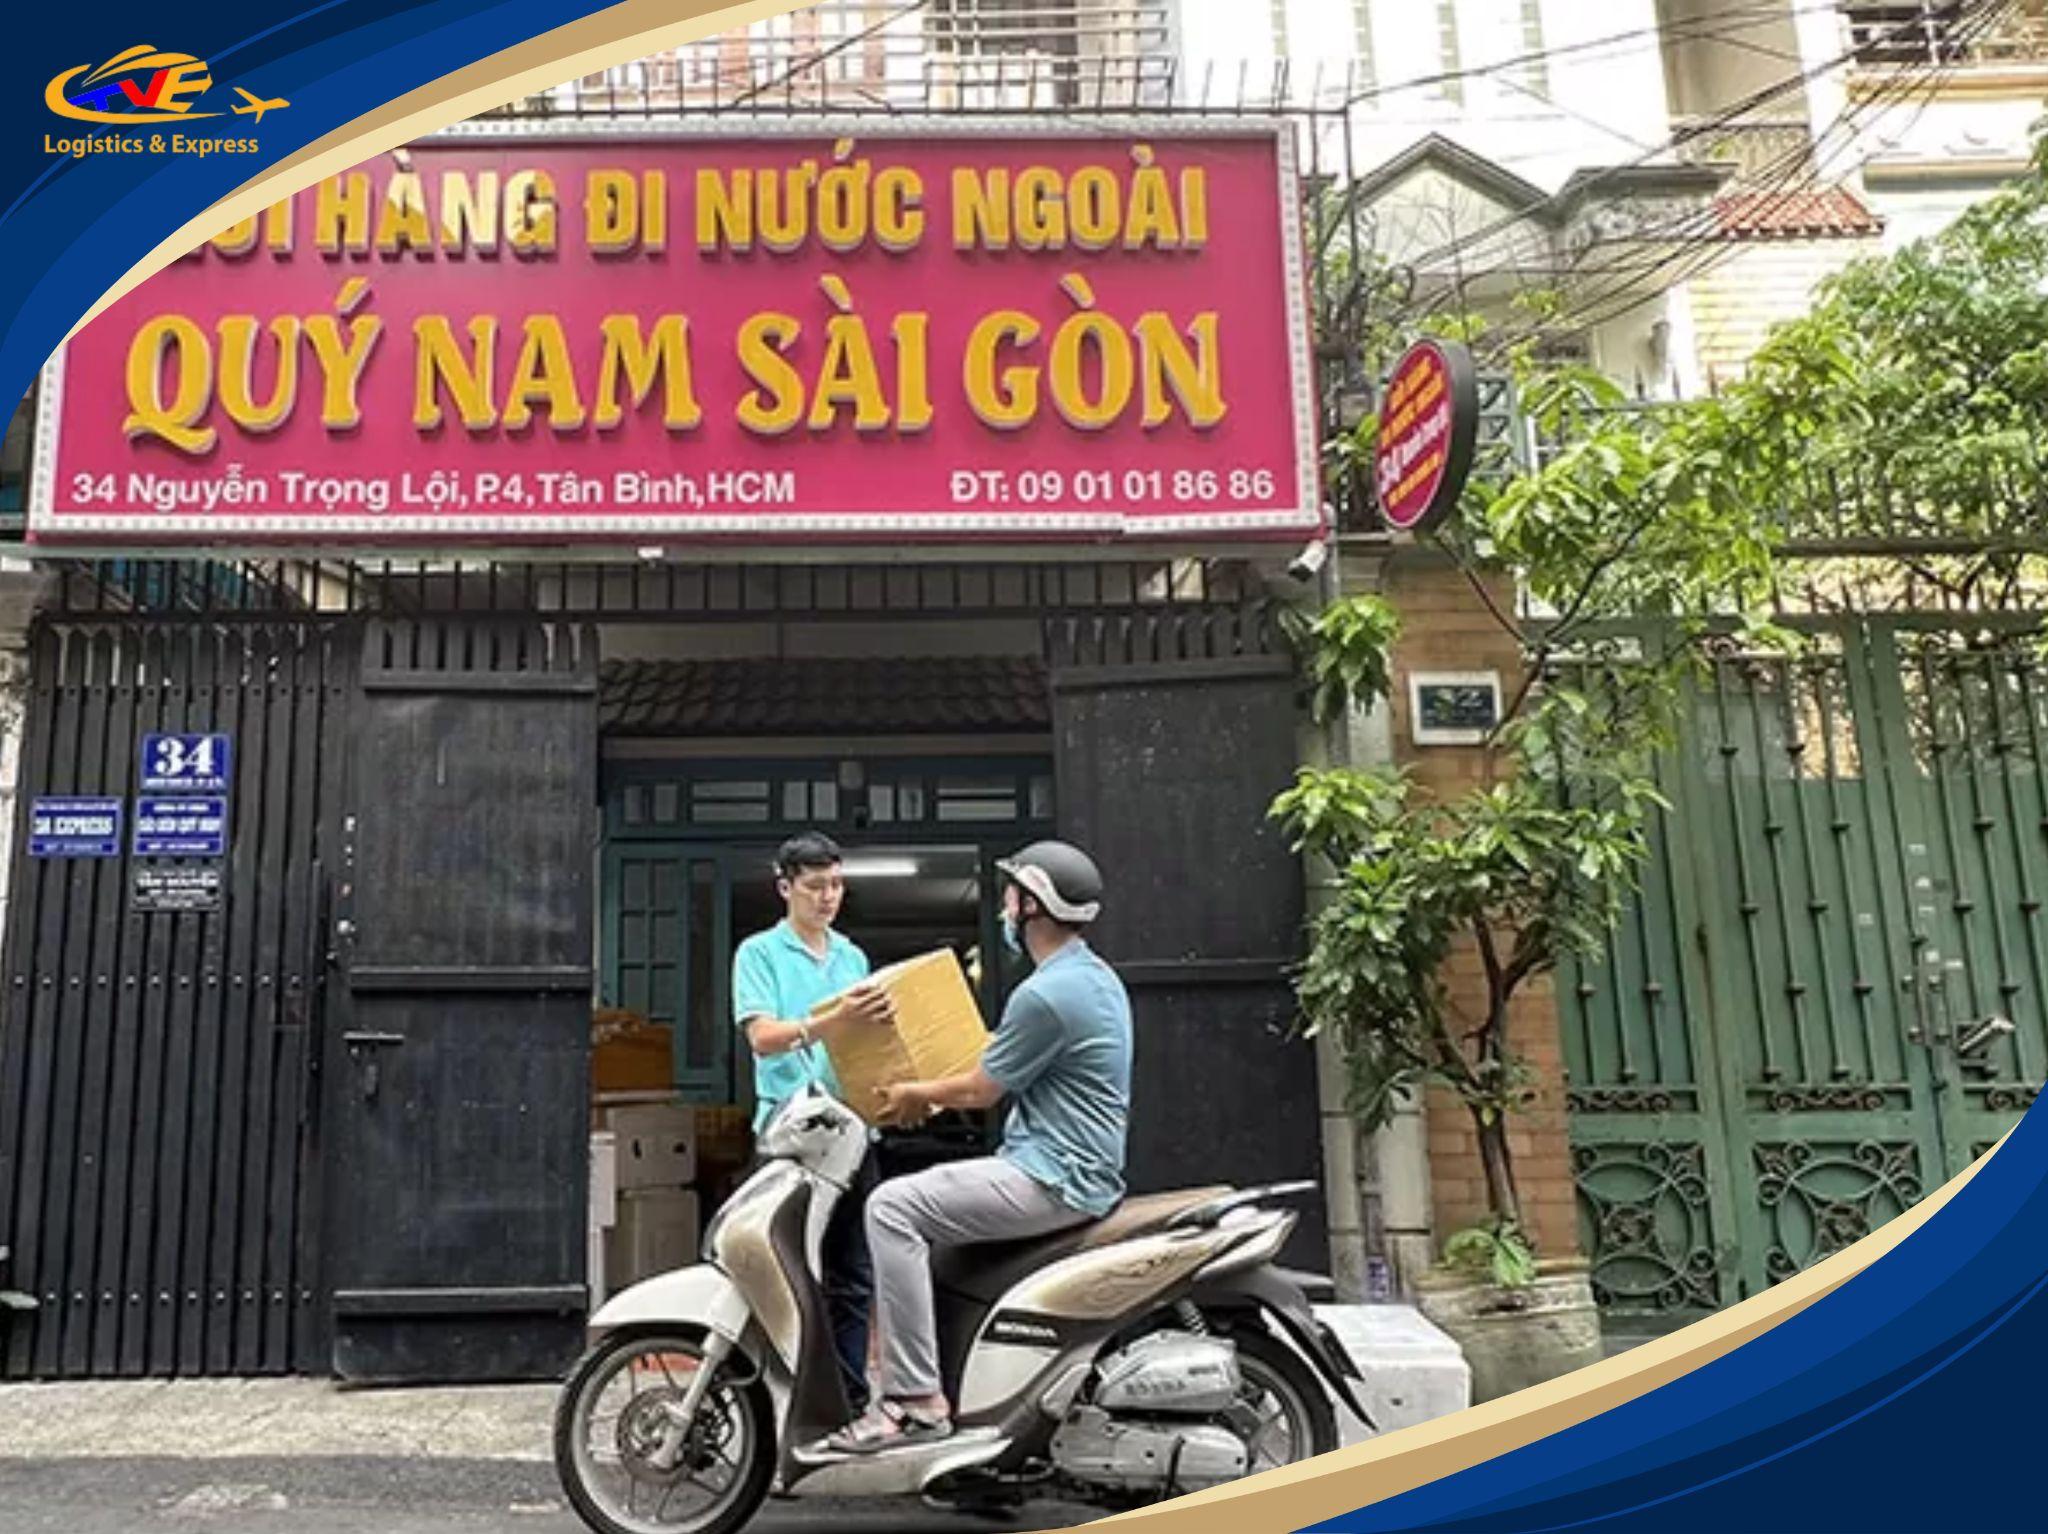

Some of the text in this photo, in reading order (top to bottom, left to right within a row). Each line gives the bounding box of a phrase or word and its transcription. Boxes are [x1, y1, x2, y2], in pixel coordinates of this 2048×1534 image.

[314, 150, 560, 254] HÀNG
[583, 170, 668, 250] ĐI
[695, 138, 926, 252] NƯỚC
[951, 146, 1208, 251] NGOÀI
[123, 276, 381, 453] QUÝ
[411, 314, 701, 430] NAM
[736, 275, 934, 434] SÀI
[964, 273, 1228, 431] GÒN
[72, 473, 117, 503] 34
[127, 463, 267, 511] Nguyễn
[280, 472, 389, 511] Trọng
[950, 469, 1275, 502] ĐT: 09 01 01 86 86
[154, 736, 214, 776] 34
